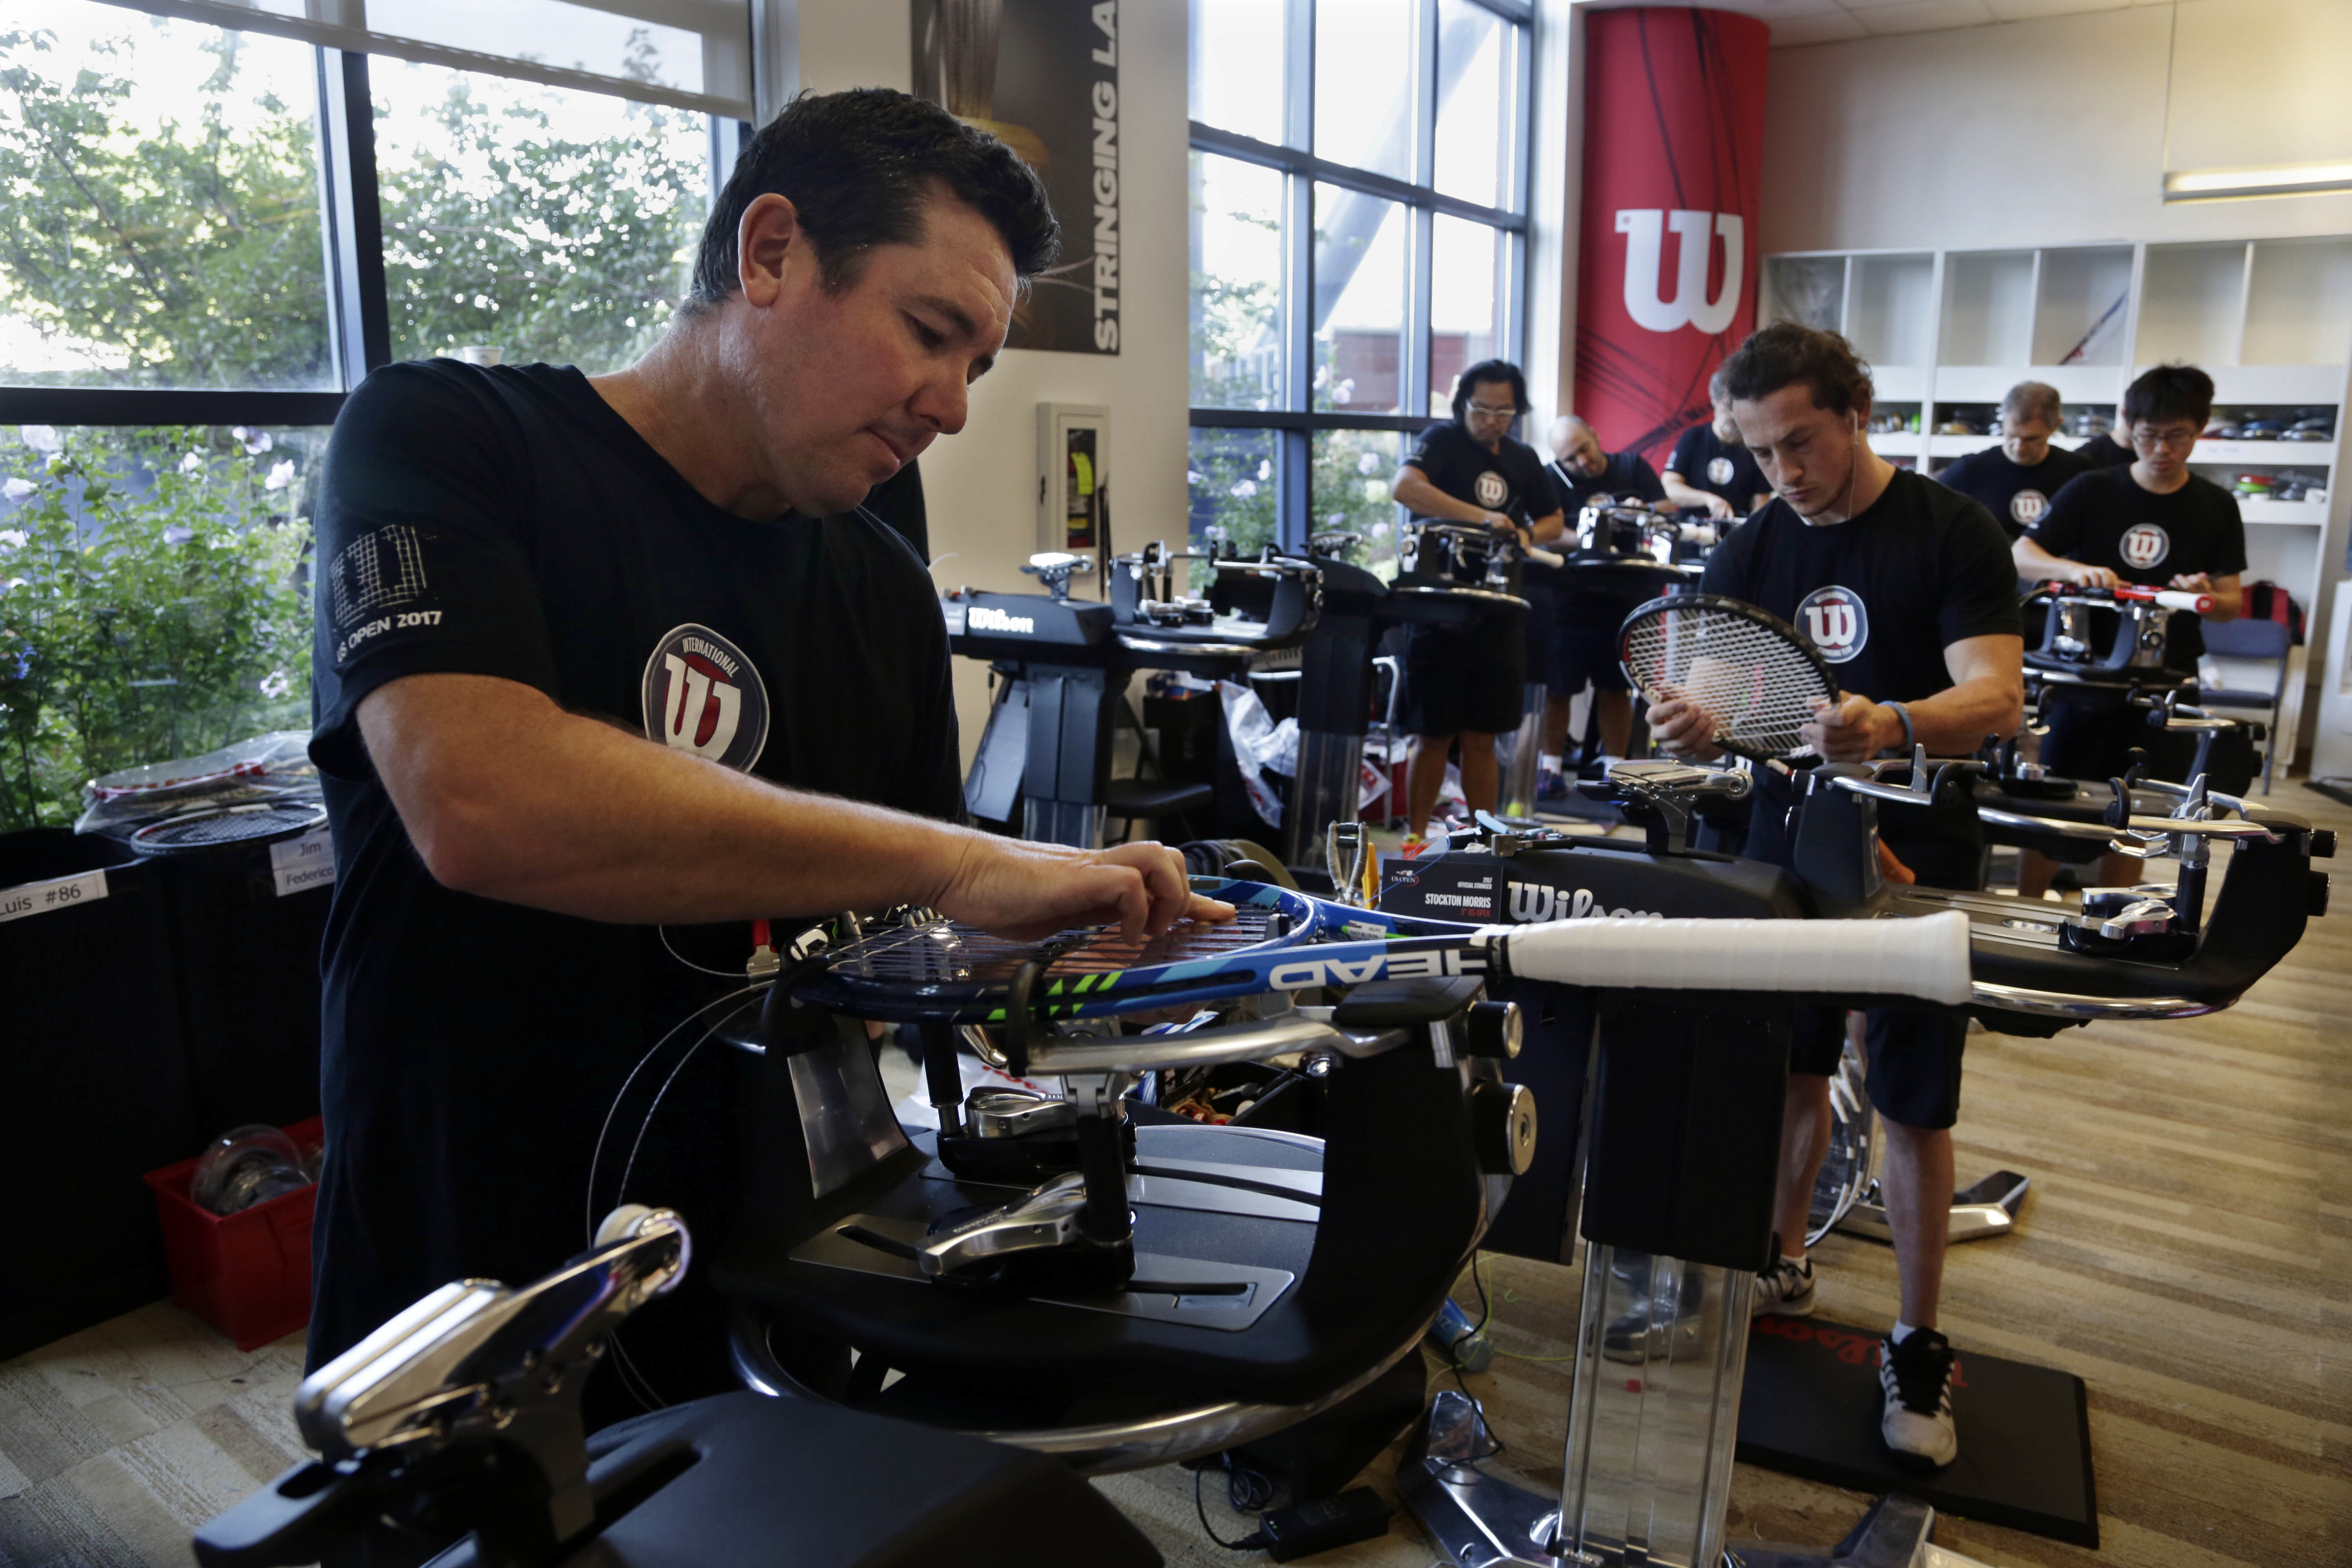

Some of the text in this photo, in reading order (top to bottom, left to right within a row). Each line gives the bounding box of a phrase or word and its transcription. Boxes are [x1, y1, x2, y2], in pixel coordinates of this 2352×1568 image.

[1092, 80, 1118, 352] STRINGING
[1615, 209, 1744, 334] W
[348, 617, 391, 649] OPEN
[397, 611, 443, 628] 2017
[968, 607, 1034, 633] Wilson
[682, 637, 739, 678] INTERNATIONAL
[300, 842, 321, 856] Jim
[286, 866, 334, 886] Federico
[45, 883, 81, 904] #86
[1425, 893, 1491, 909] STOCKTON MORRIS
[1468, 908, 1476, 916] US
[1476, 909, 1491, 918] OPEN
[1269, 949, 1488, 991] HEAD
